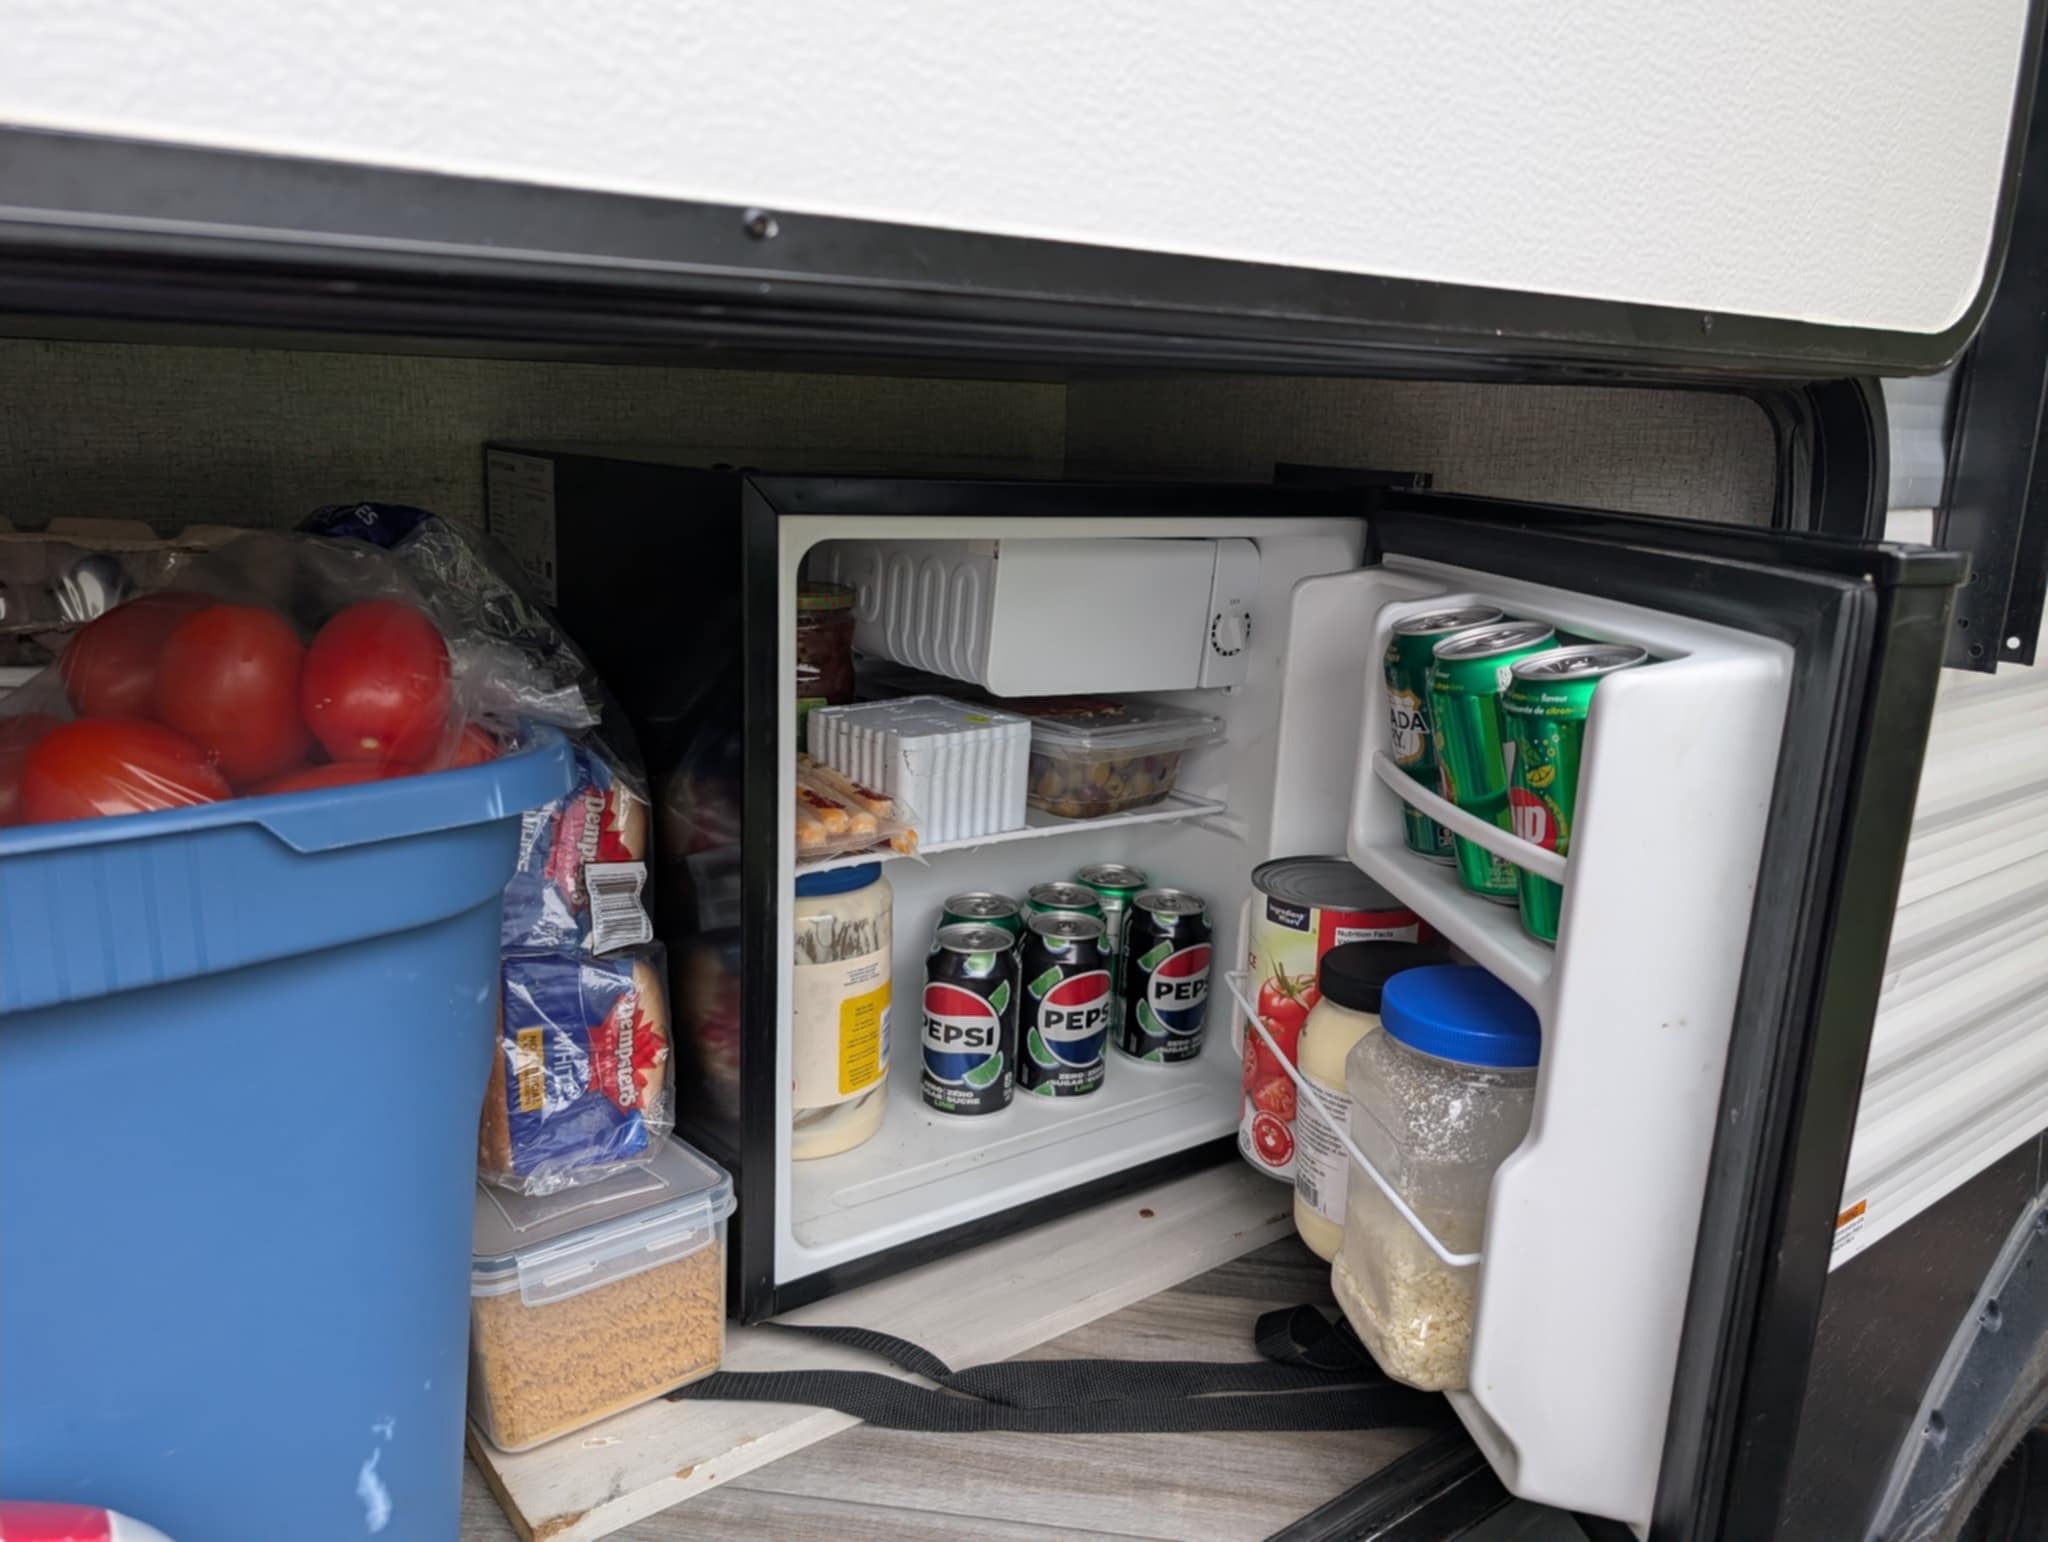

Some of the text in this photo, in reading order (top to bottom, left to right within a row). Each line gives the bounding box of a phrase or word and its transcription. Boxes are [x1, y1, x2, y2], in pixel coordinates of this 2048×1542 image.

[1391, 708, 1427, 732] ADA
[1155, 979, 1208, 1000] PEP
[1044, 1001, 1109, 1030] PEPS
